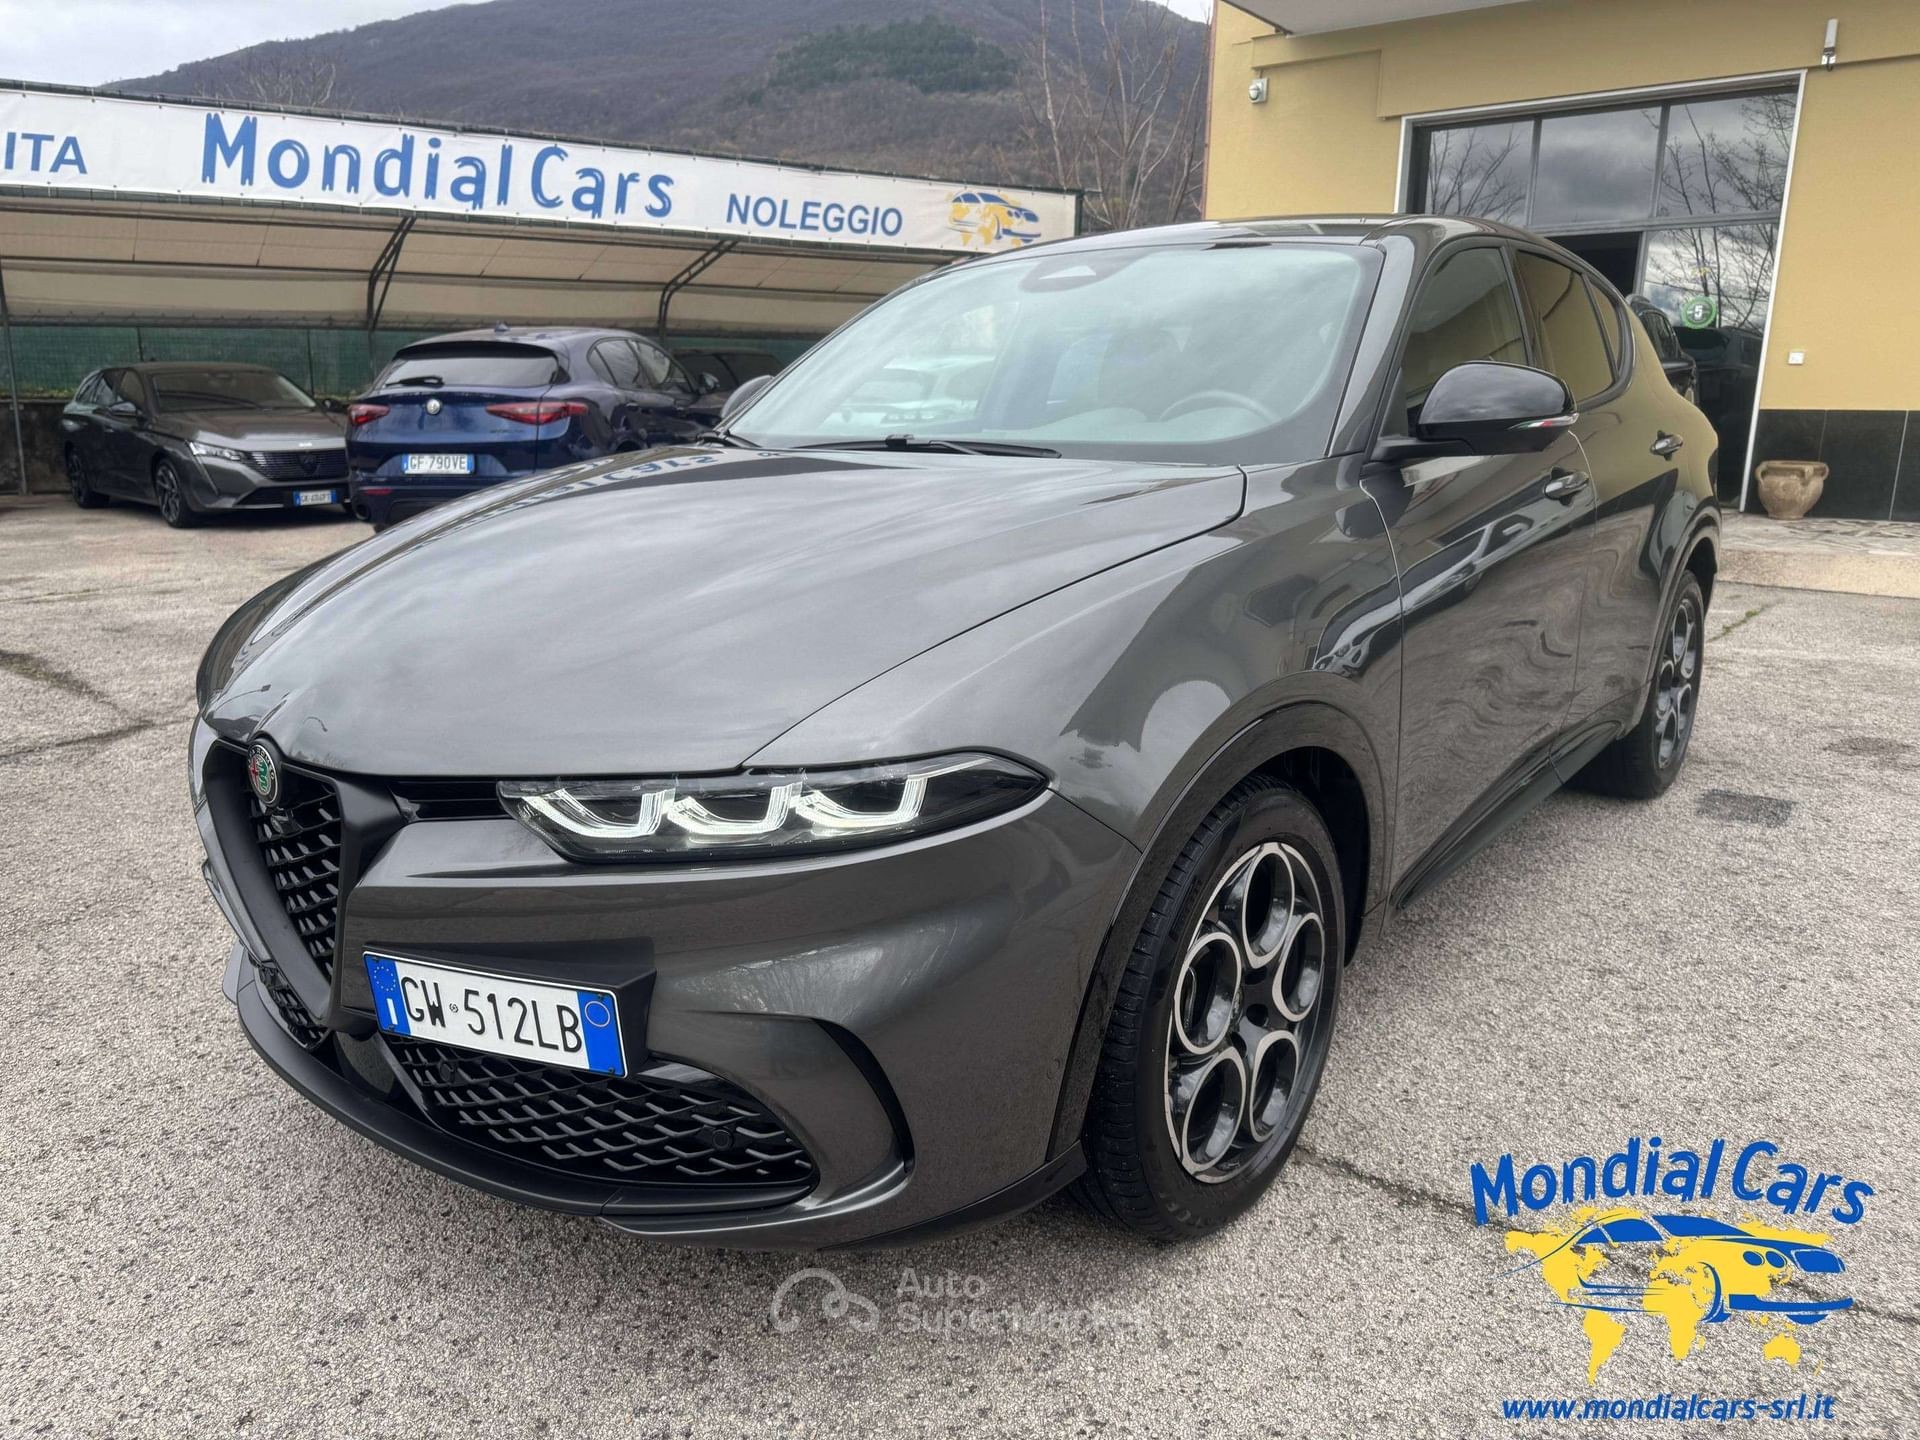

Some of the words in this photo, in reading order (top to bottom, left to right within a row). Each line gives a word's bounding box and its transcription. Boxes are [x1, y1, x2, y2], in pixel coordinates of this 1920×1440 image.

[201, 112, 512, 210] Mondial
[531, 144, 675, 219] Cars
[726, 193, 903, 238] NOLEGGIO
[429, 456, 466, 470] 790VE
[401, 976, 446, 1028] GW
[463, 988, 583, 1053] 512LB
